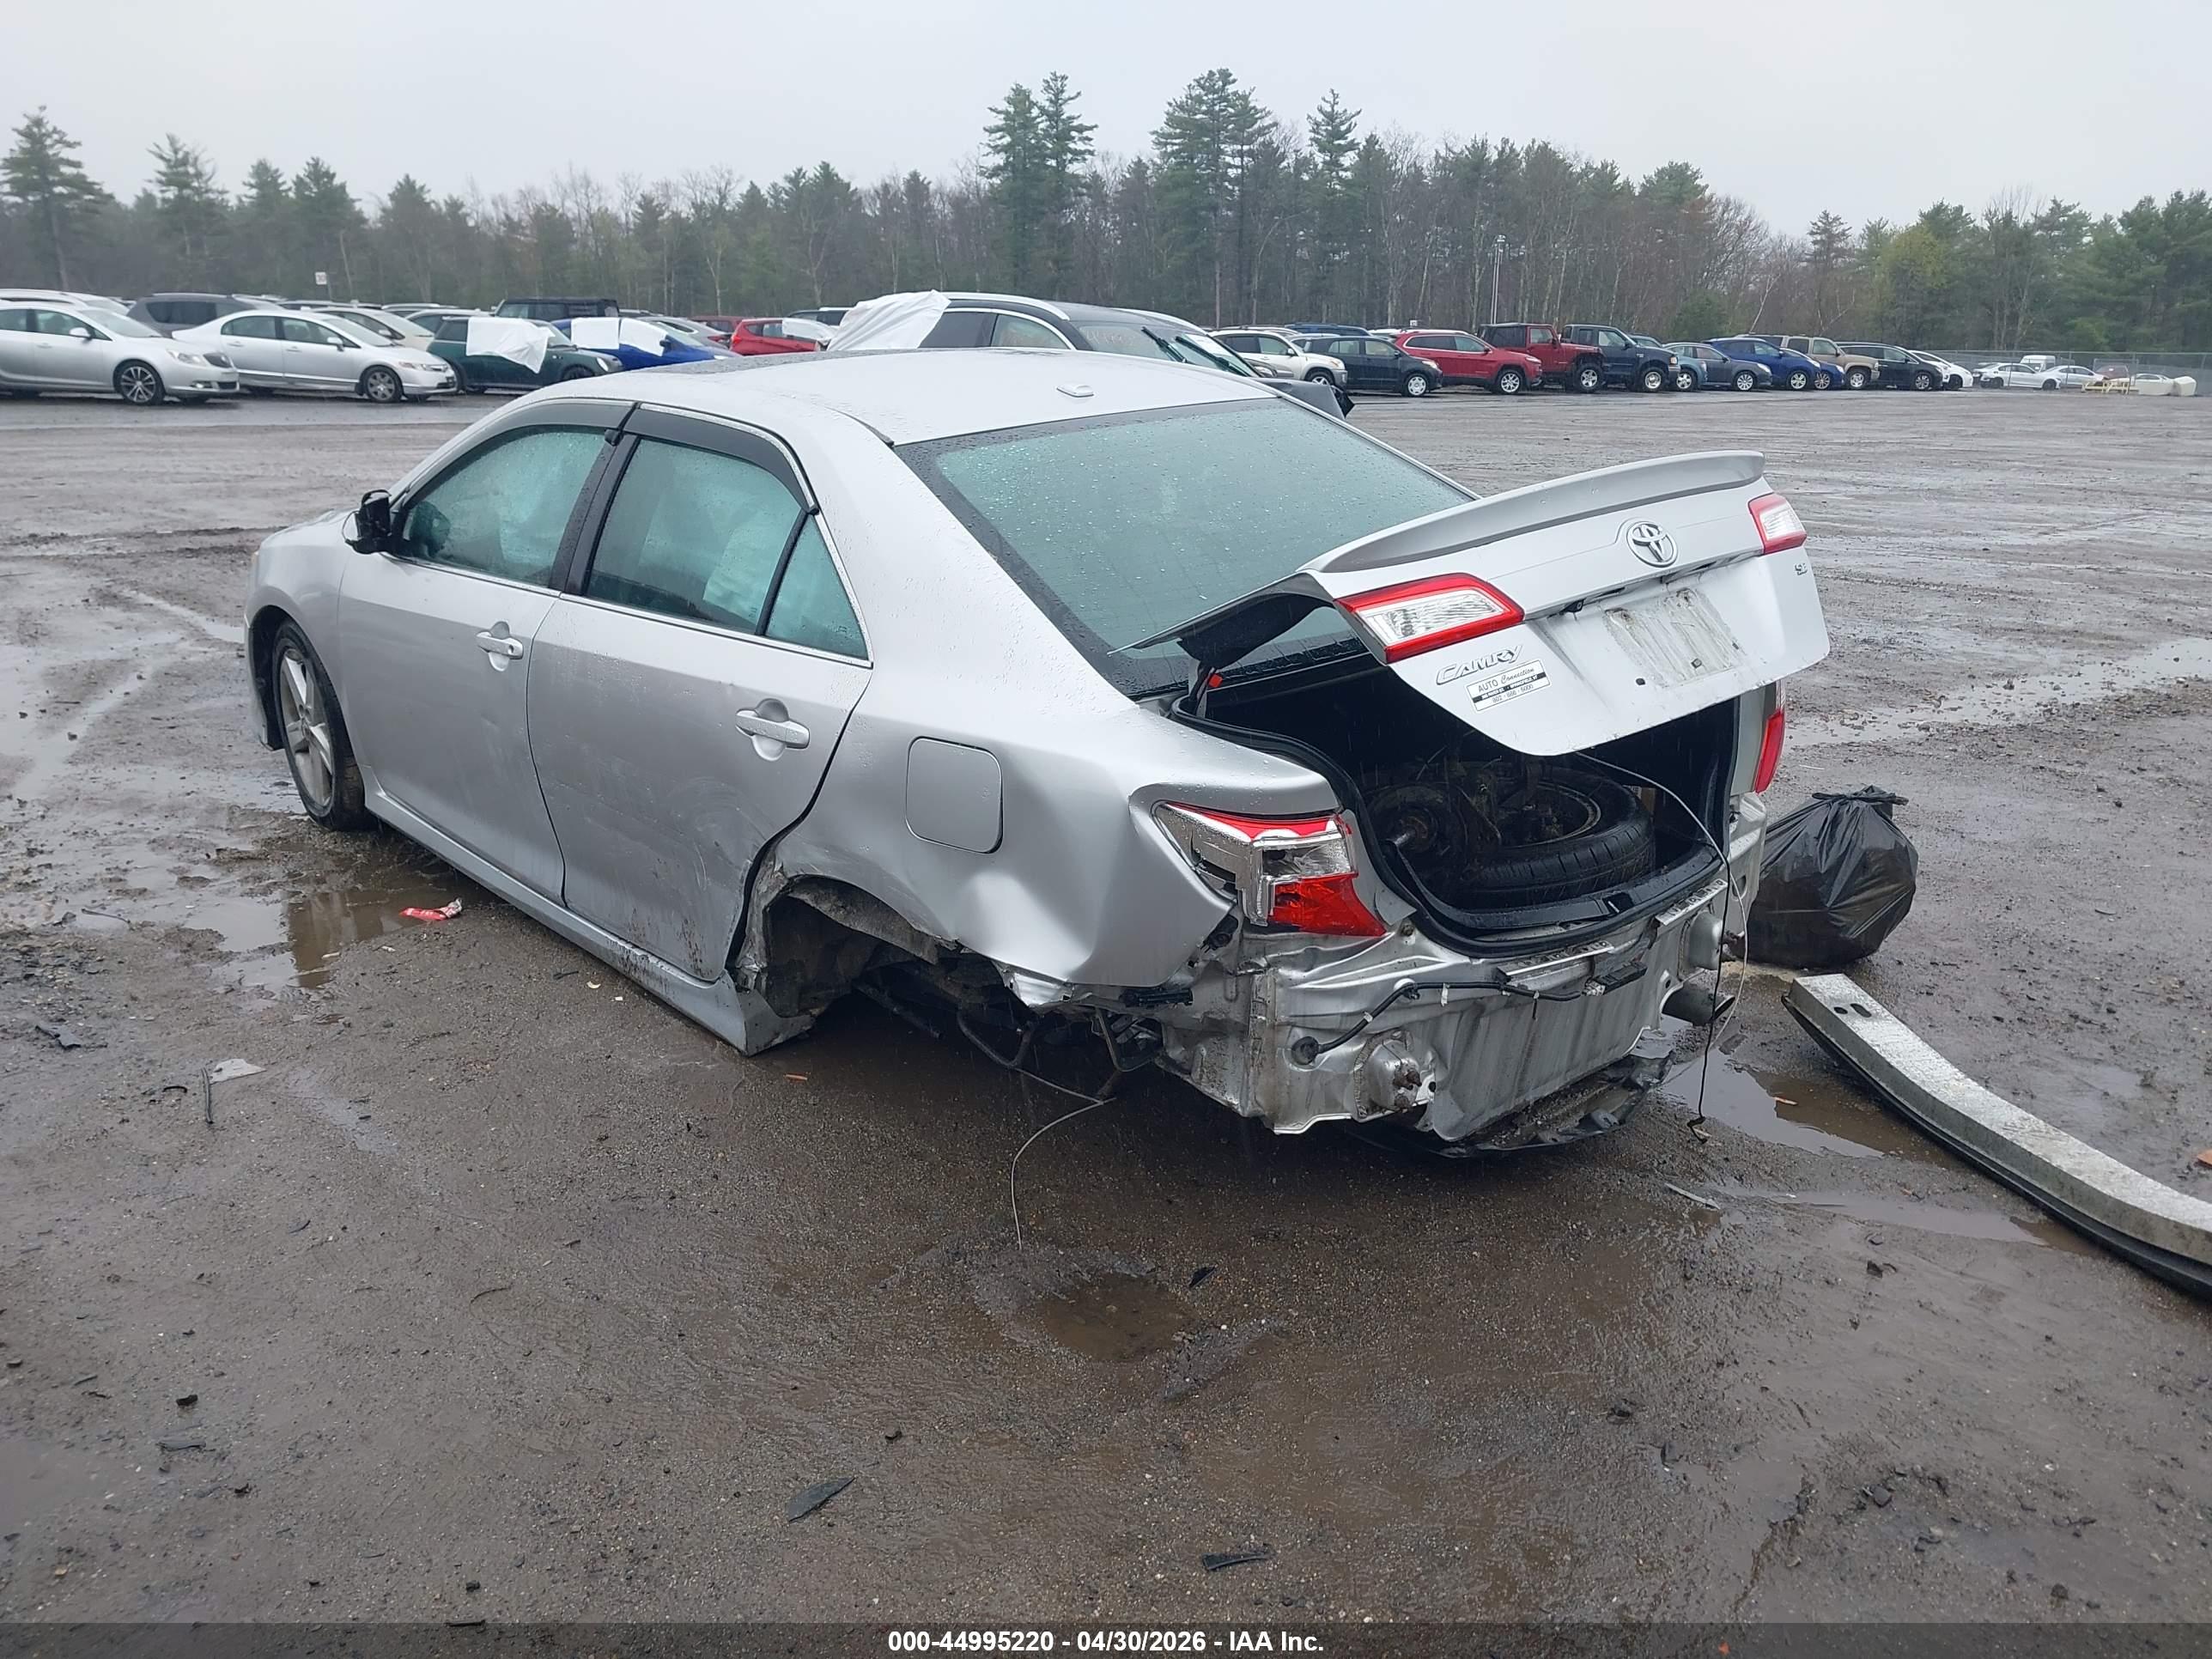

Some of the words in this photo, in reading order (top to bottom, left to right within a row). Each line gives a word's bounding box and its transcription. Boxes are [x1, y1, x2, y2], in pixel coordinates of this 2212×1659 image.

[1437, 646, 1523, 685] CAMRY
[1479, 679, 1498, 692] AUTO
[1501, 668, 1534, 684] Connection
